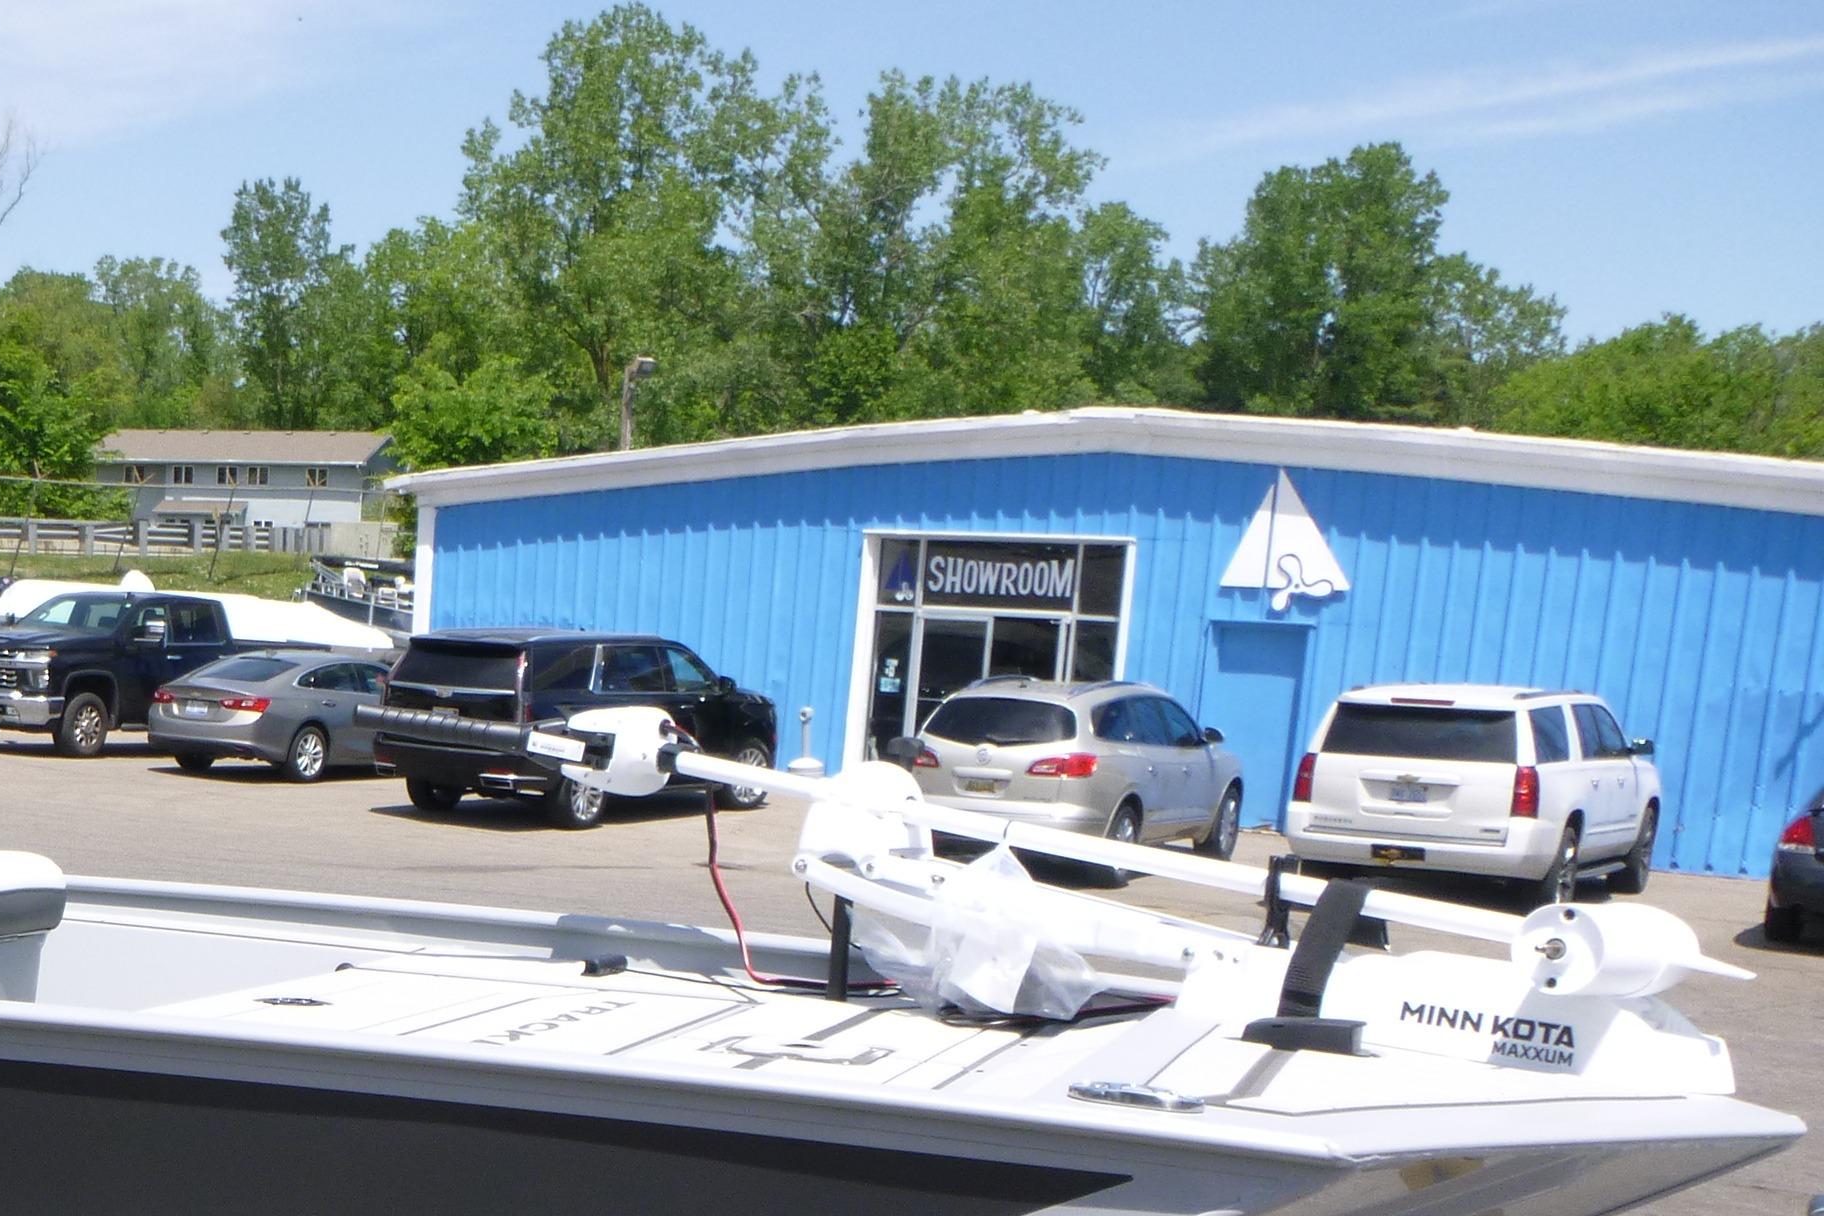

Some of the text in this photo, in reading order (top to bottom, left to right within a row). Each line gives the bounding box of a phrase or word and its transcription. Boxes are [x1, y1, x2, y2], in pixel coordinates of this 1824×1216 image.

[928, 556, 1074, 597] SHOWROOM
[1399, 1001, 1575, 1049] MINN KOTA
[1491, 1041, 1574, 1067] MAXXUM
